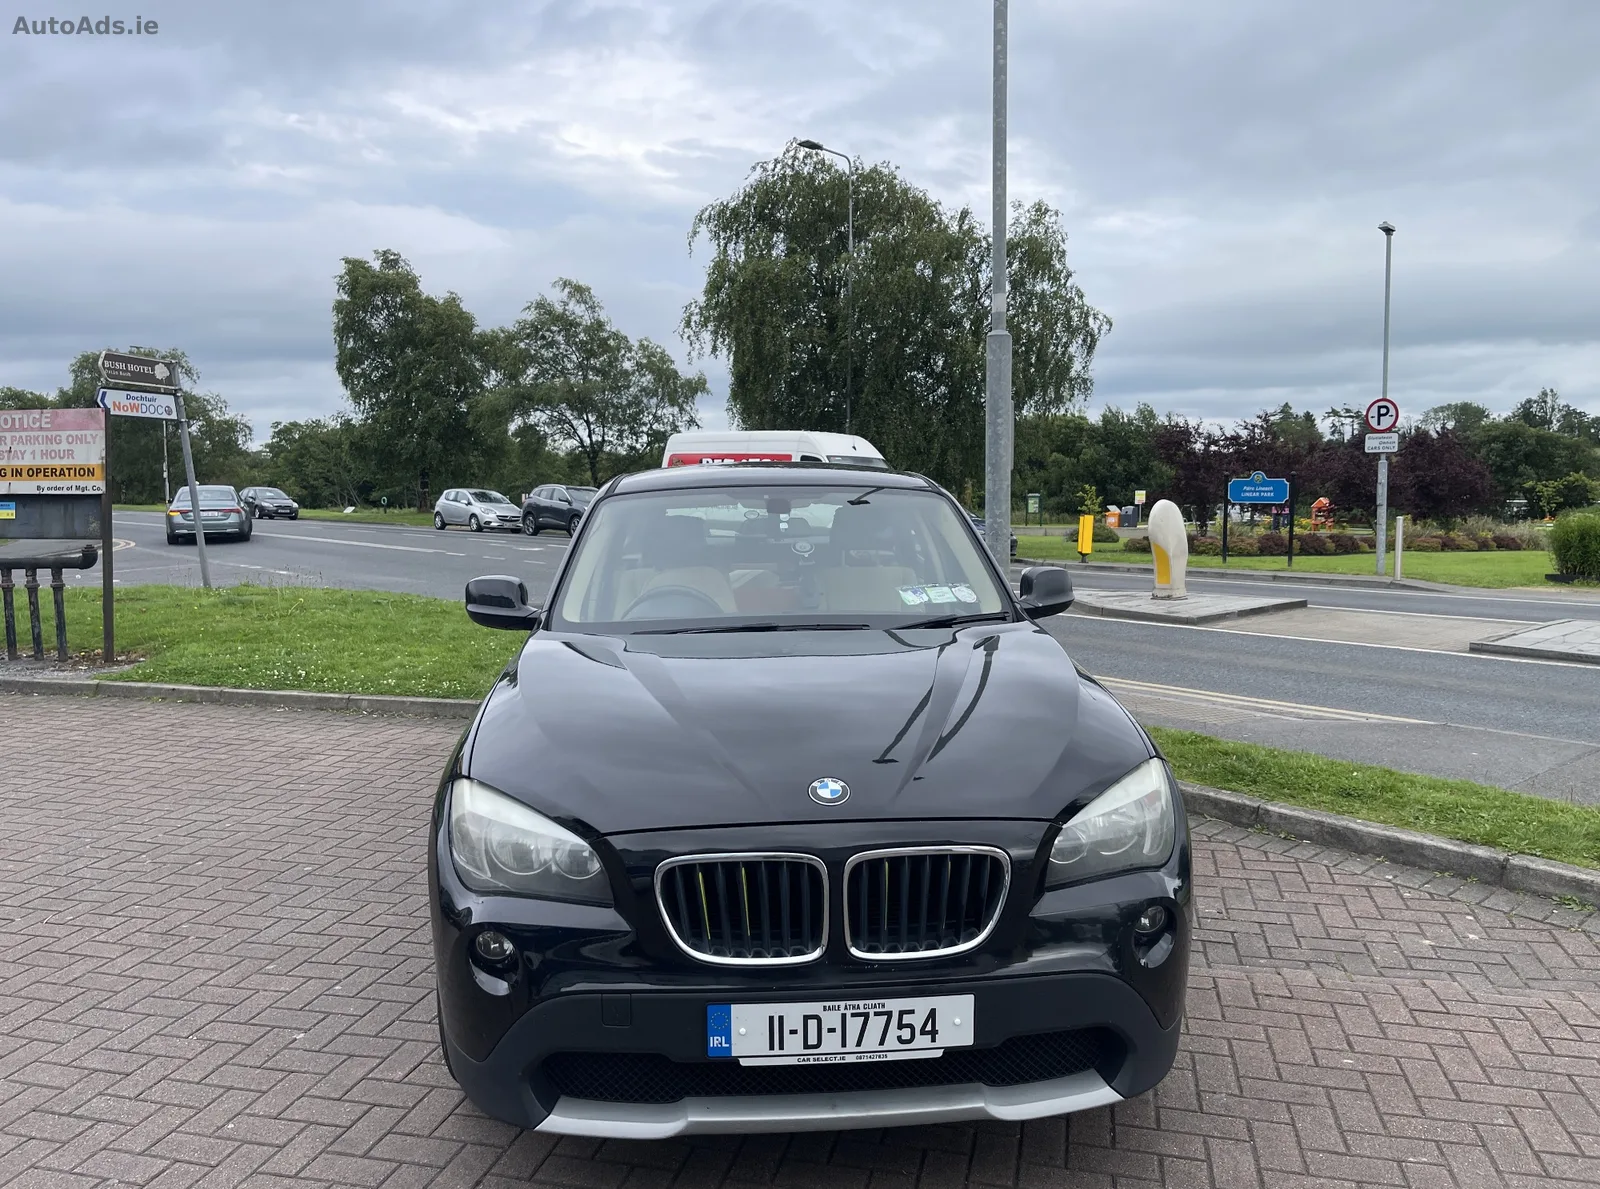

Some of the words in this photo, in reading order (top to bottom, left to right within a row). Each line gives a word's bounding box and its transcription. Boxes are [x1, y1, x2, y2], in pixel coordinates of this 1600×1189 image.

[104, 360, 126, 371] BUSH
[127, 363, 154, 375] HOTEL
[1377, 405, 1390, 426] P
[10, 434, 62, 445] PARKING
[66, 434, 98, 445] ONLY
[0, 450, 26, 460] STAY
[30, 450, 36, 460] 1
[41, 449, 75, 460] HOUR
[11, 468, 23, 477] IN
[27, 467, 95, 477] OPERATION
[822, 1004, 841, 1012] BAILE
[843, 1003, 860, 1011] ÁTHA
[863, 1002, 886, 1010] CLIATH
[768, 1008, 939, 1051] 11-D-17754
[709, 1036, 729, 1048] IRL
